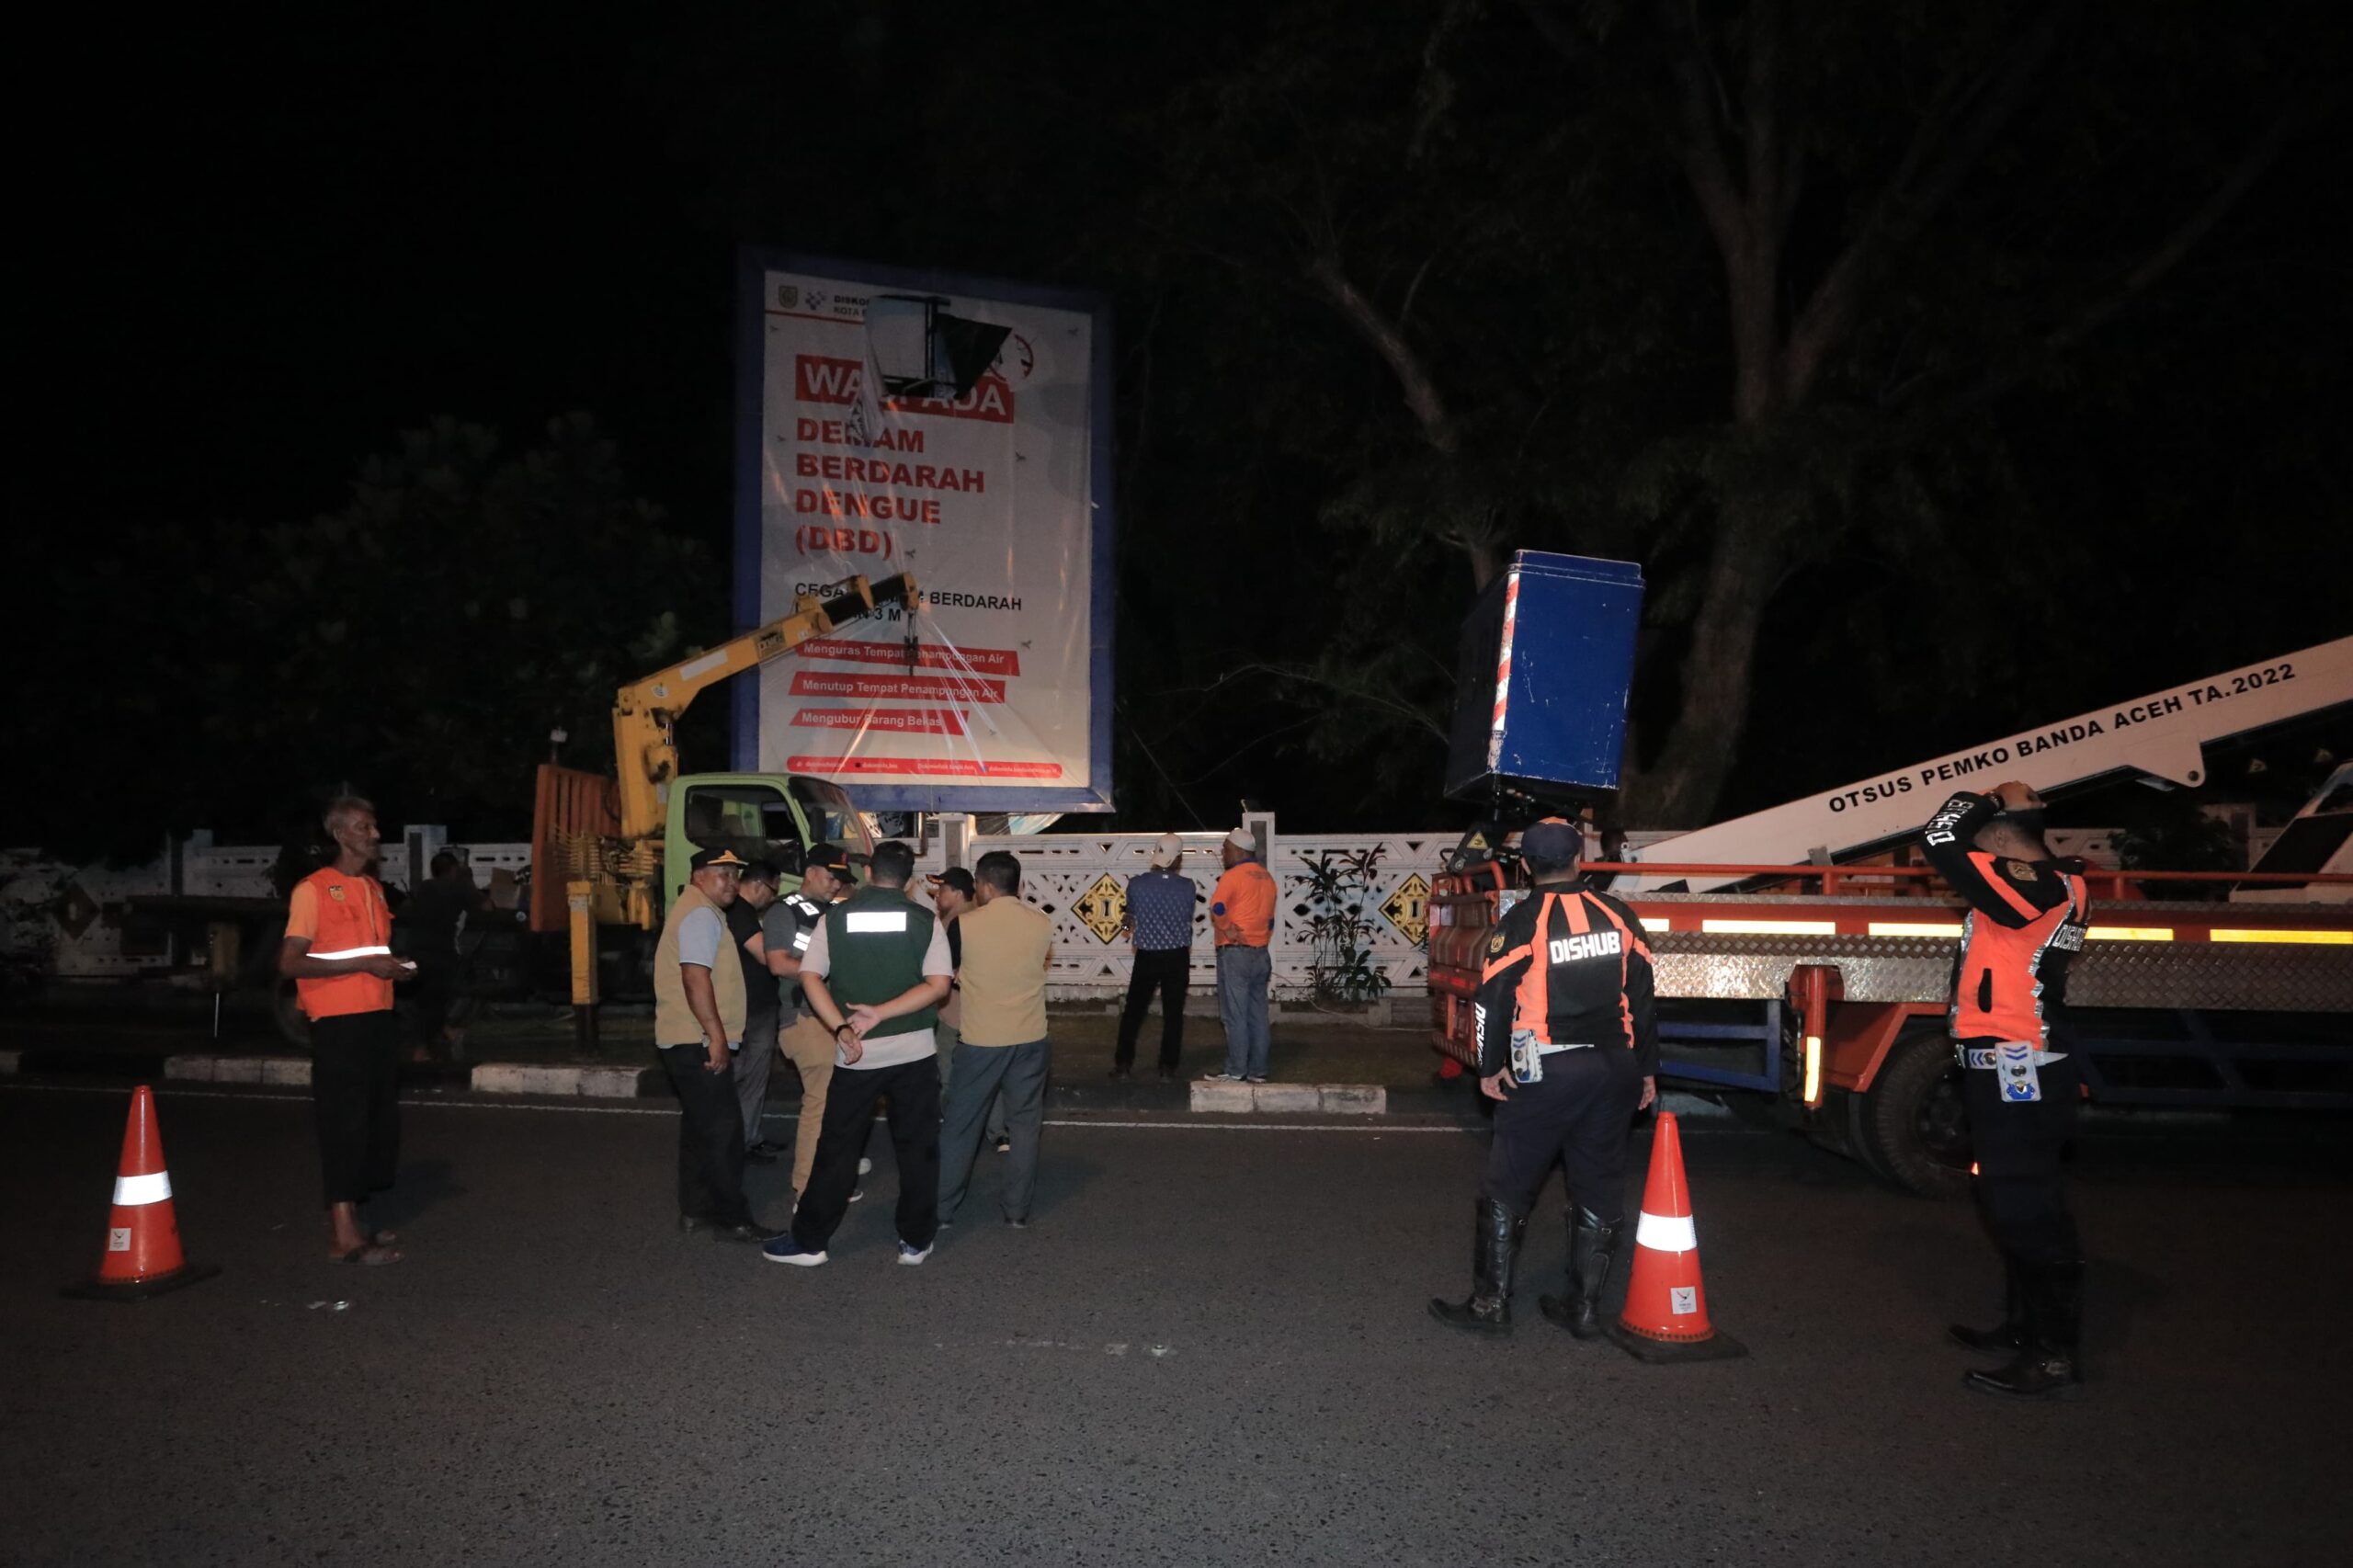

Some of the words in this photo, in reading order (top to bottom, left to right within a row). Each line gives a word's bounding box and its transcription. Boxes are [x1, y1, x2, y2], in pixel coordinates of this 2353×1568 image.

[796, 453, 984, 493] BERDARAH
[796, 488, 940, 524] DENGUE
[796, 525, 892, 561] (DBD)
[874, 608, 883, 620] 3
[888, 608, 901, 621] M
[930, 591, 1022, 611] BERDARAH
[803, 643, 861, 657] Menguras
[863, 646, 904, 659] Tempat
[988, 653, 1005, 665] Air
[802, 679, 854, 694] Menutup
[858, 682, 898, 696] Tempat
[901, 683, 980, 700] Penampungan
[982, 687, 997, 699] Air
[801, 712, 861, 726] Mengubur
[907, 715, 942, 727] Bekas
[1828, 776, 1913, 813] OTSUS
[1920, 746, 2010, 786] PEMKO
[2015, 720, 2105, 758] BANDA
[2114, 695, 2184, 730] ACEH
[2187, 663, 2296, 706] TA.2022
[1549, 930, 1621, 965] DISHUB
